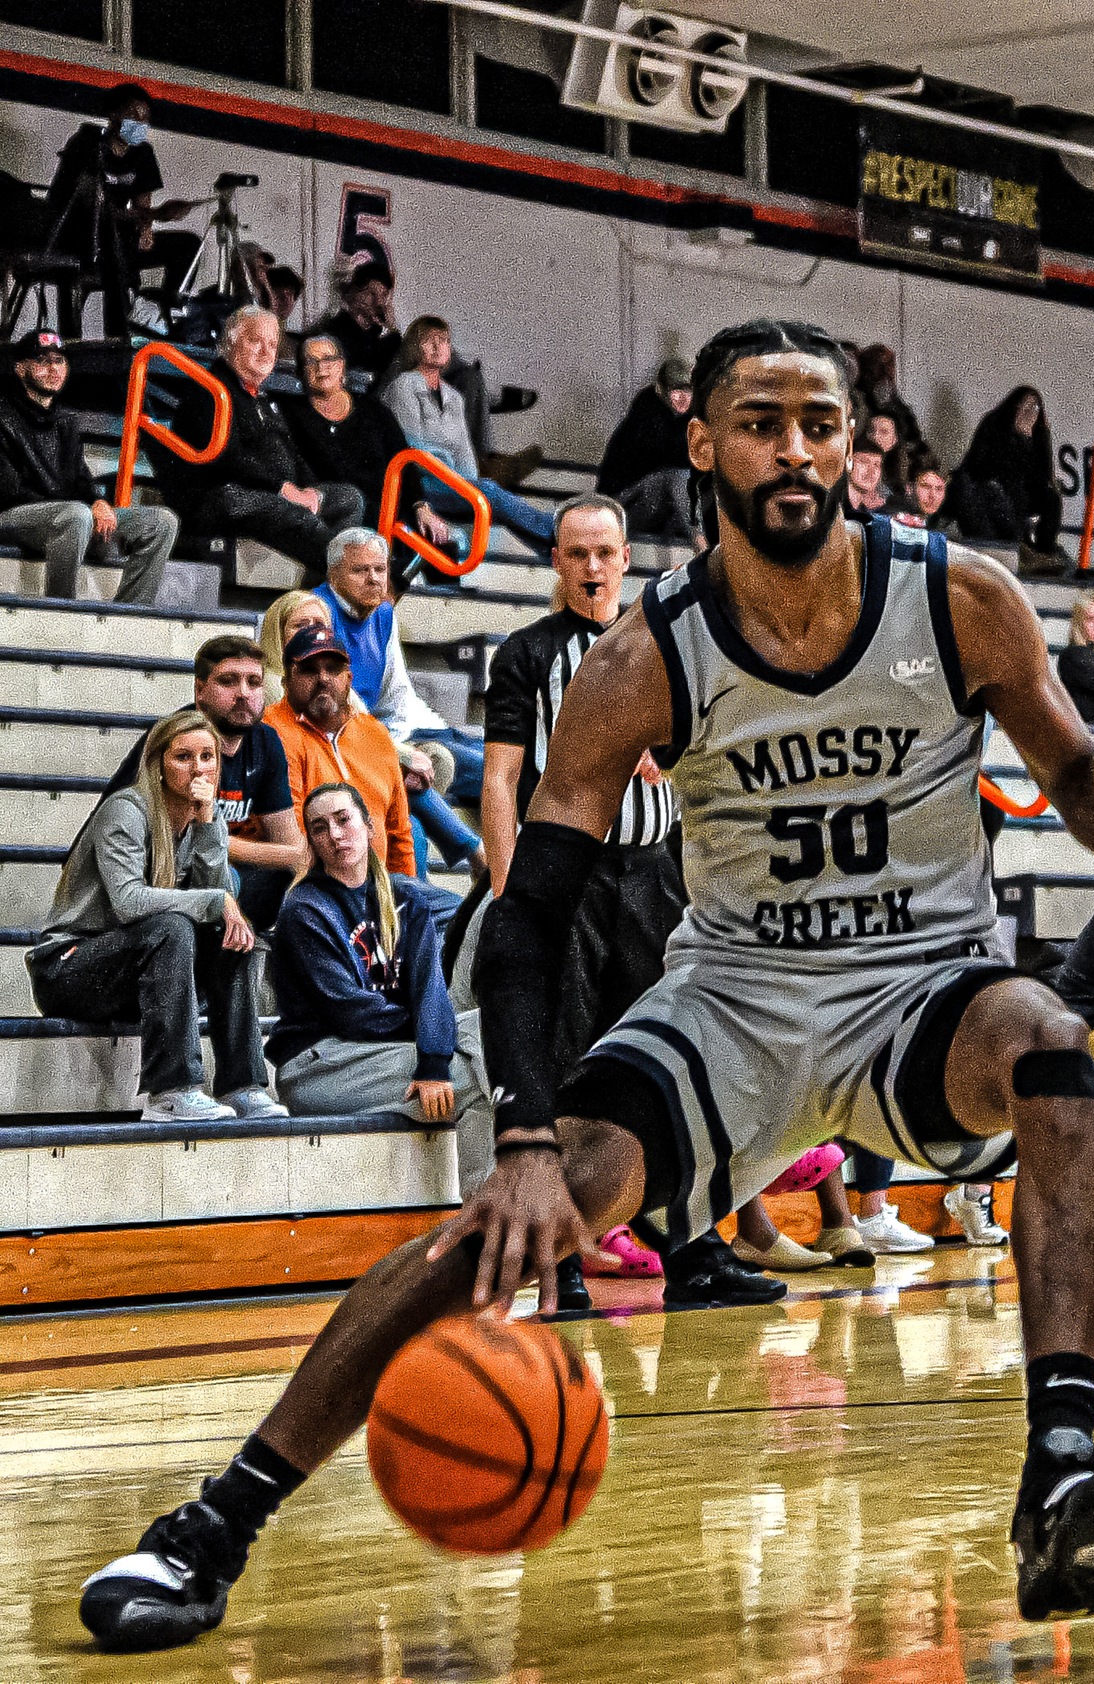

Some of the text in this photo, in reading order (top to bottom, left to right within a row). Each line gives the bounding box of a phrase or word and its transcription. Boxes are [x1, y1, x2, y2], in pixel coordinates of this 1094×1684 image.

[336, 182, 396, 291] 5
[726, 726, 921, 794] MOSSY
[765, 800, 889, 884] 50
[753, 886, 917, 945] CREEK
